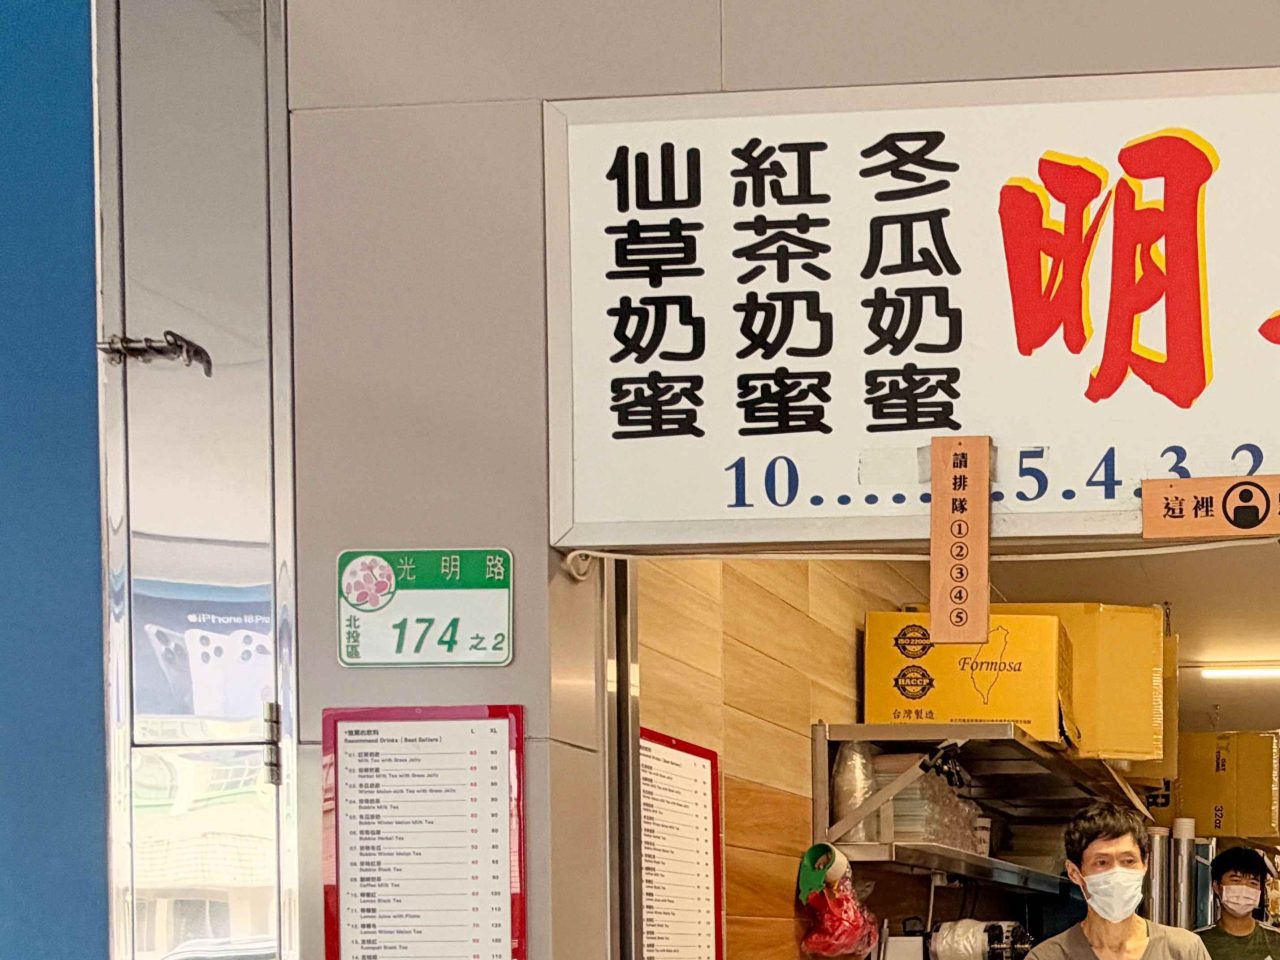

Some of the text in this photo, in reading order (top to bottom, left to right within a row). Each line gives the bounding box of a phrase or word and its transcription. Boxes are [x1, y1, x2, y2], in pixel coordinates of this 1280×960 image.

[605, 143, 705, 439] 仙草奶蜜
[731, 138, 833, 436] 紅茶奶蜜
[859, 131, 962, 432] 冬瓜奶蜜
[1163, 495, 1214, 519] 這裡
[397, 555, 505, 580] 光明路
[345, 615, 361, 659] 北投區
[392, 617, 460, 654] 174
[958, 656, 1023, 672] Formosa
[898, 678, 930, 687] HACCP
[893, 709, 934, 720] 台灣製造
[1214, 805, 1224, 830] 32oz
